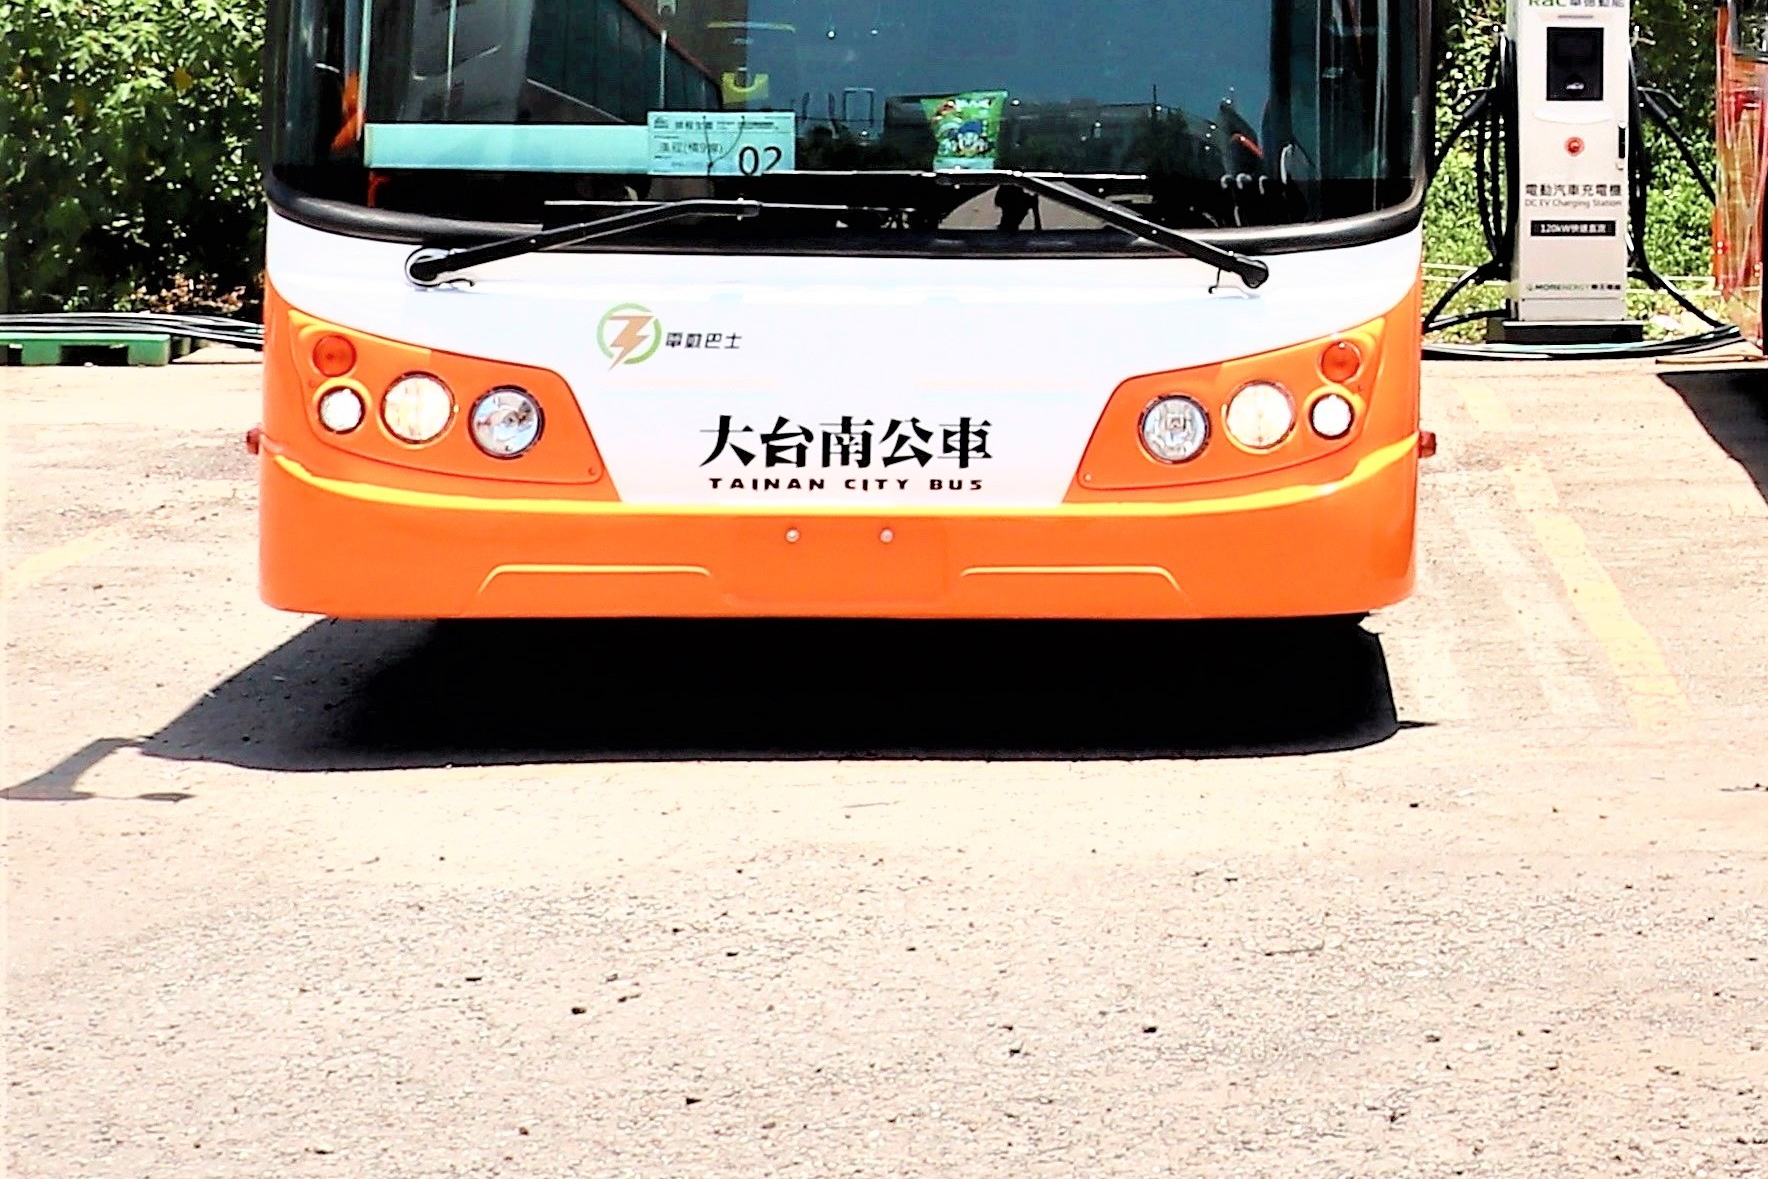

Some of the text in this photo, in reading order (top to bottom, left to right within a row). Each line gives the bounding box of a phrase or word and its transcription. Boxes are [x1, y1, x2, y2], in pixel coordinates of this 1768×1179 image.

[738, 146, 782, 176] 02
[699, 414, 993, 469] 大台南公車
[709, 477, 983, 491] TAINAN CITY BUS
